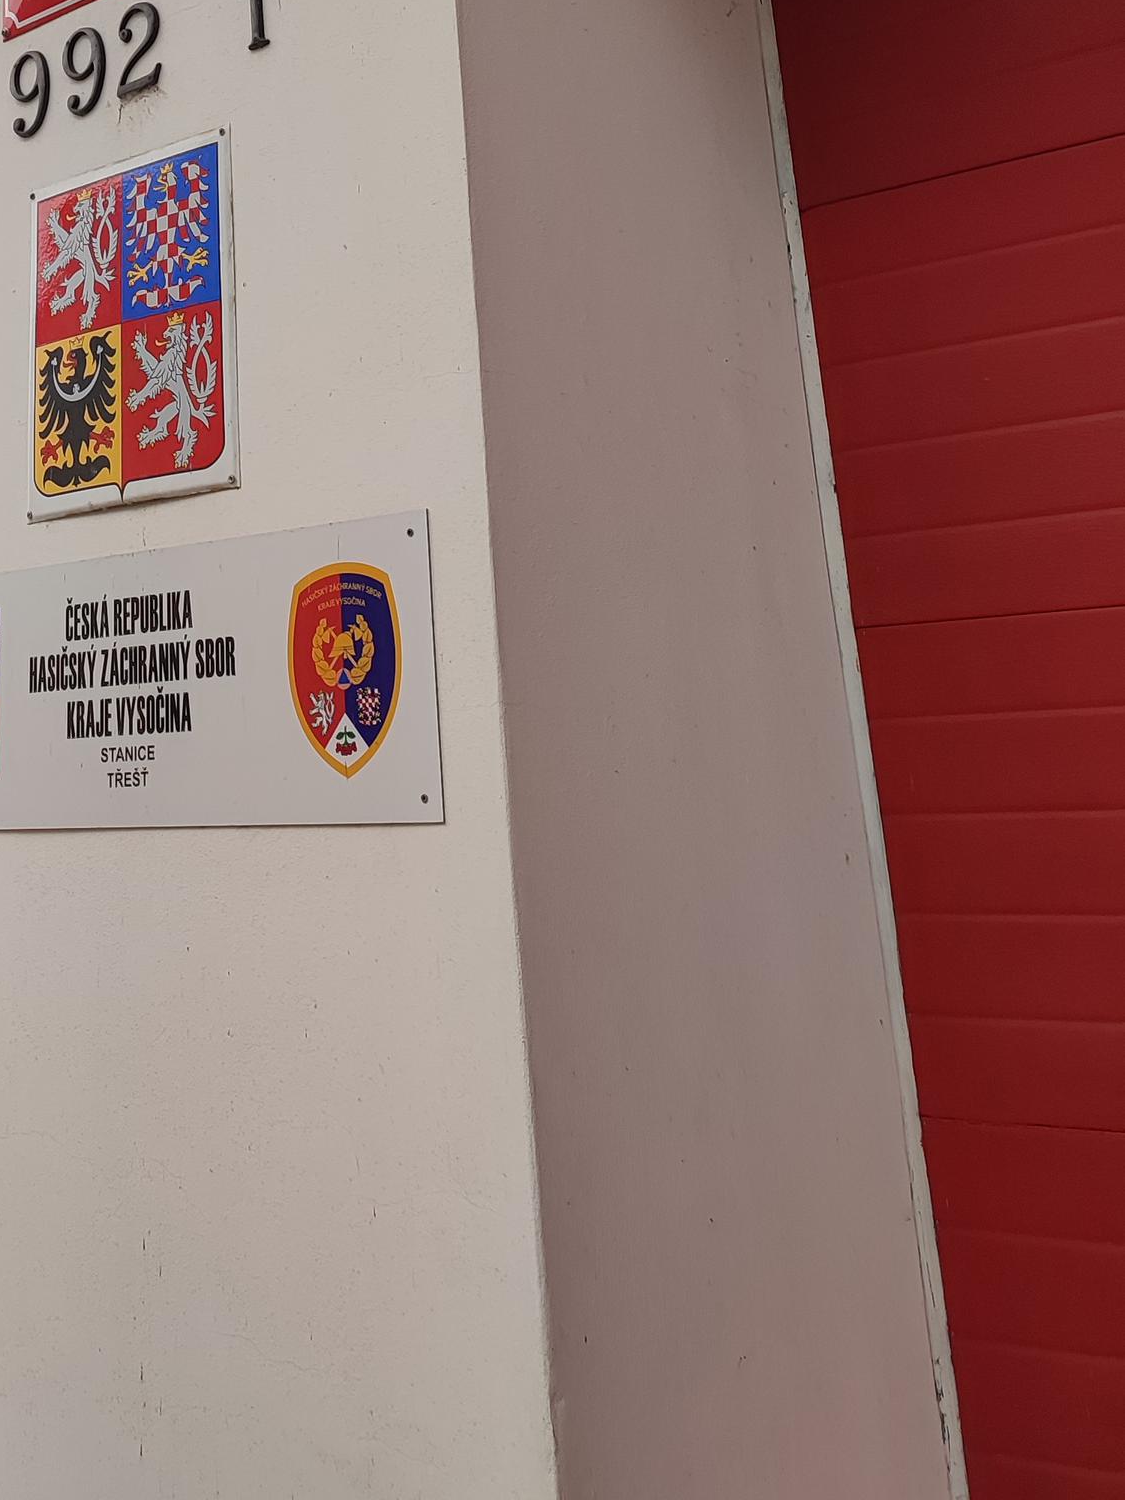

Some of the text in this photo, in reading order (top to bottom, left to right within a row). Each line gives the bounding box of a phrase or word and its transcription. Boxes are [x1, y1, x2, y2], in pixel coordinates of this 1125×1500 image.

[9, 1, 162, 139] 992
[65, 589, 193, 642] ČESKÁ REPUBLIKA
[365, 586, 383, 599] SBOR
[29, 634, 236, 694] HASIČSKÝ ZÁCHRANNÝ SBOR
[66, 686, 192, 740] KRAJE VYSOČINA
[100, 745, 156, 763] STANICE
[107, 766, 149, 788] TŘEŠŤ
